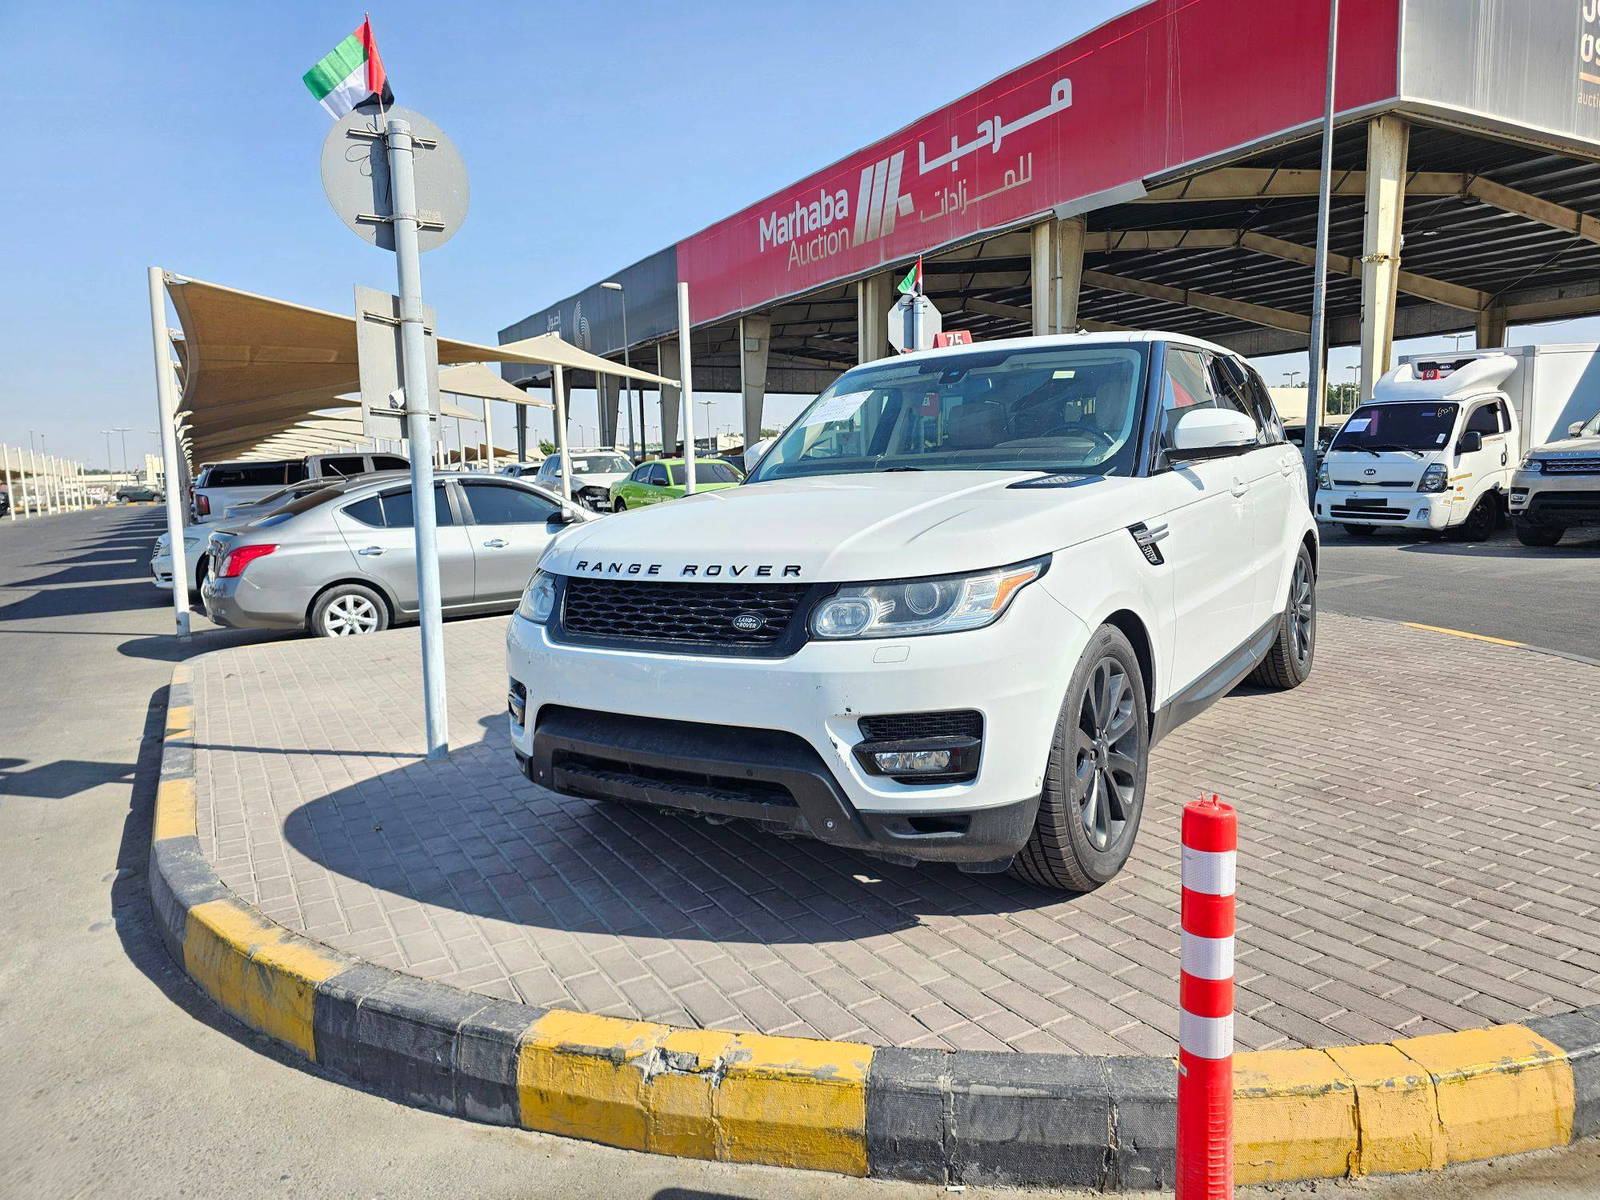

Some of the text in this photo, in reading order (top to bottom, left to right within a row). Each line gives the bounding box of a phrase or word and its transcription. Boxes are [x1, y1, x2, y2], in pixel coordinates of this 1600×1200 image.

[1577, 92, 1600, 108] aucti
[919, 78, 1072, 176] مرحبا
[759, 189, 848, 253] Marhaba
[787, 227, 850, 272] Auction
[946, 333, 964, 346] 75
[575, 560, 802, 577] RANGE ROVER
